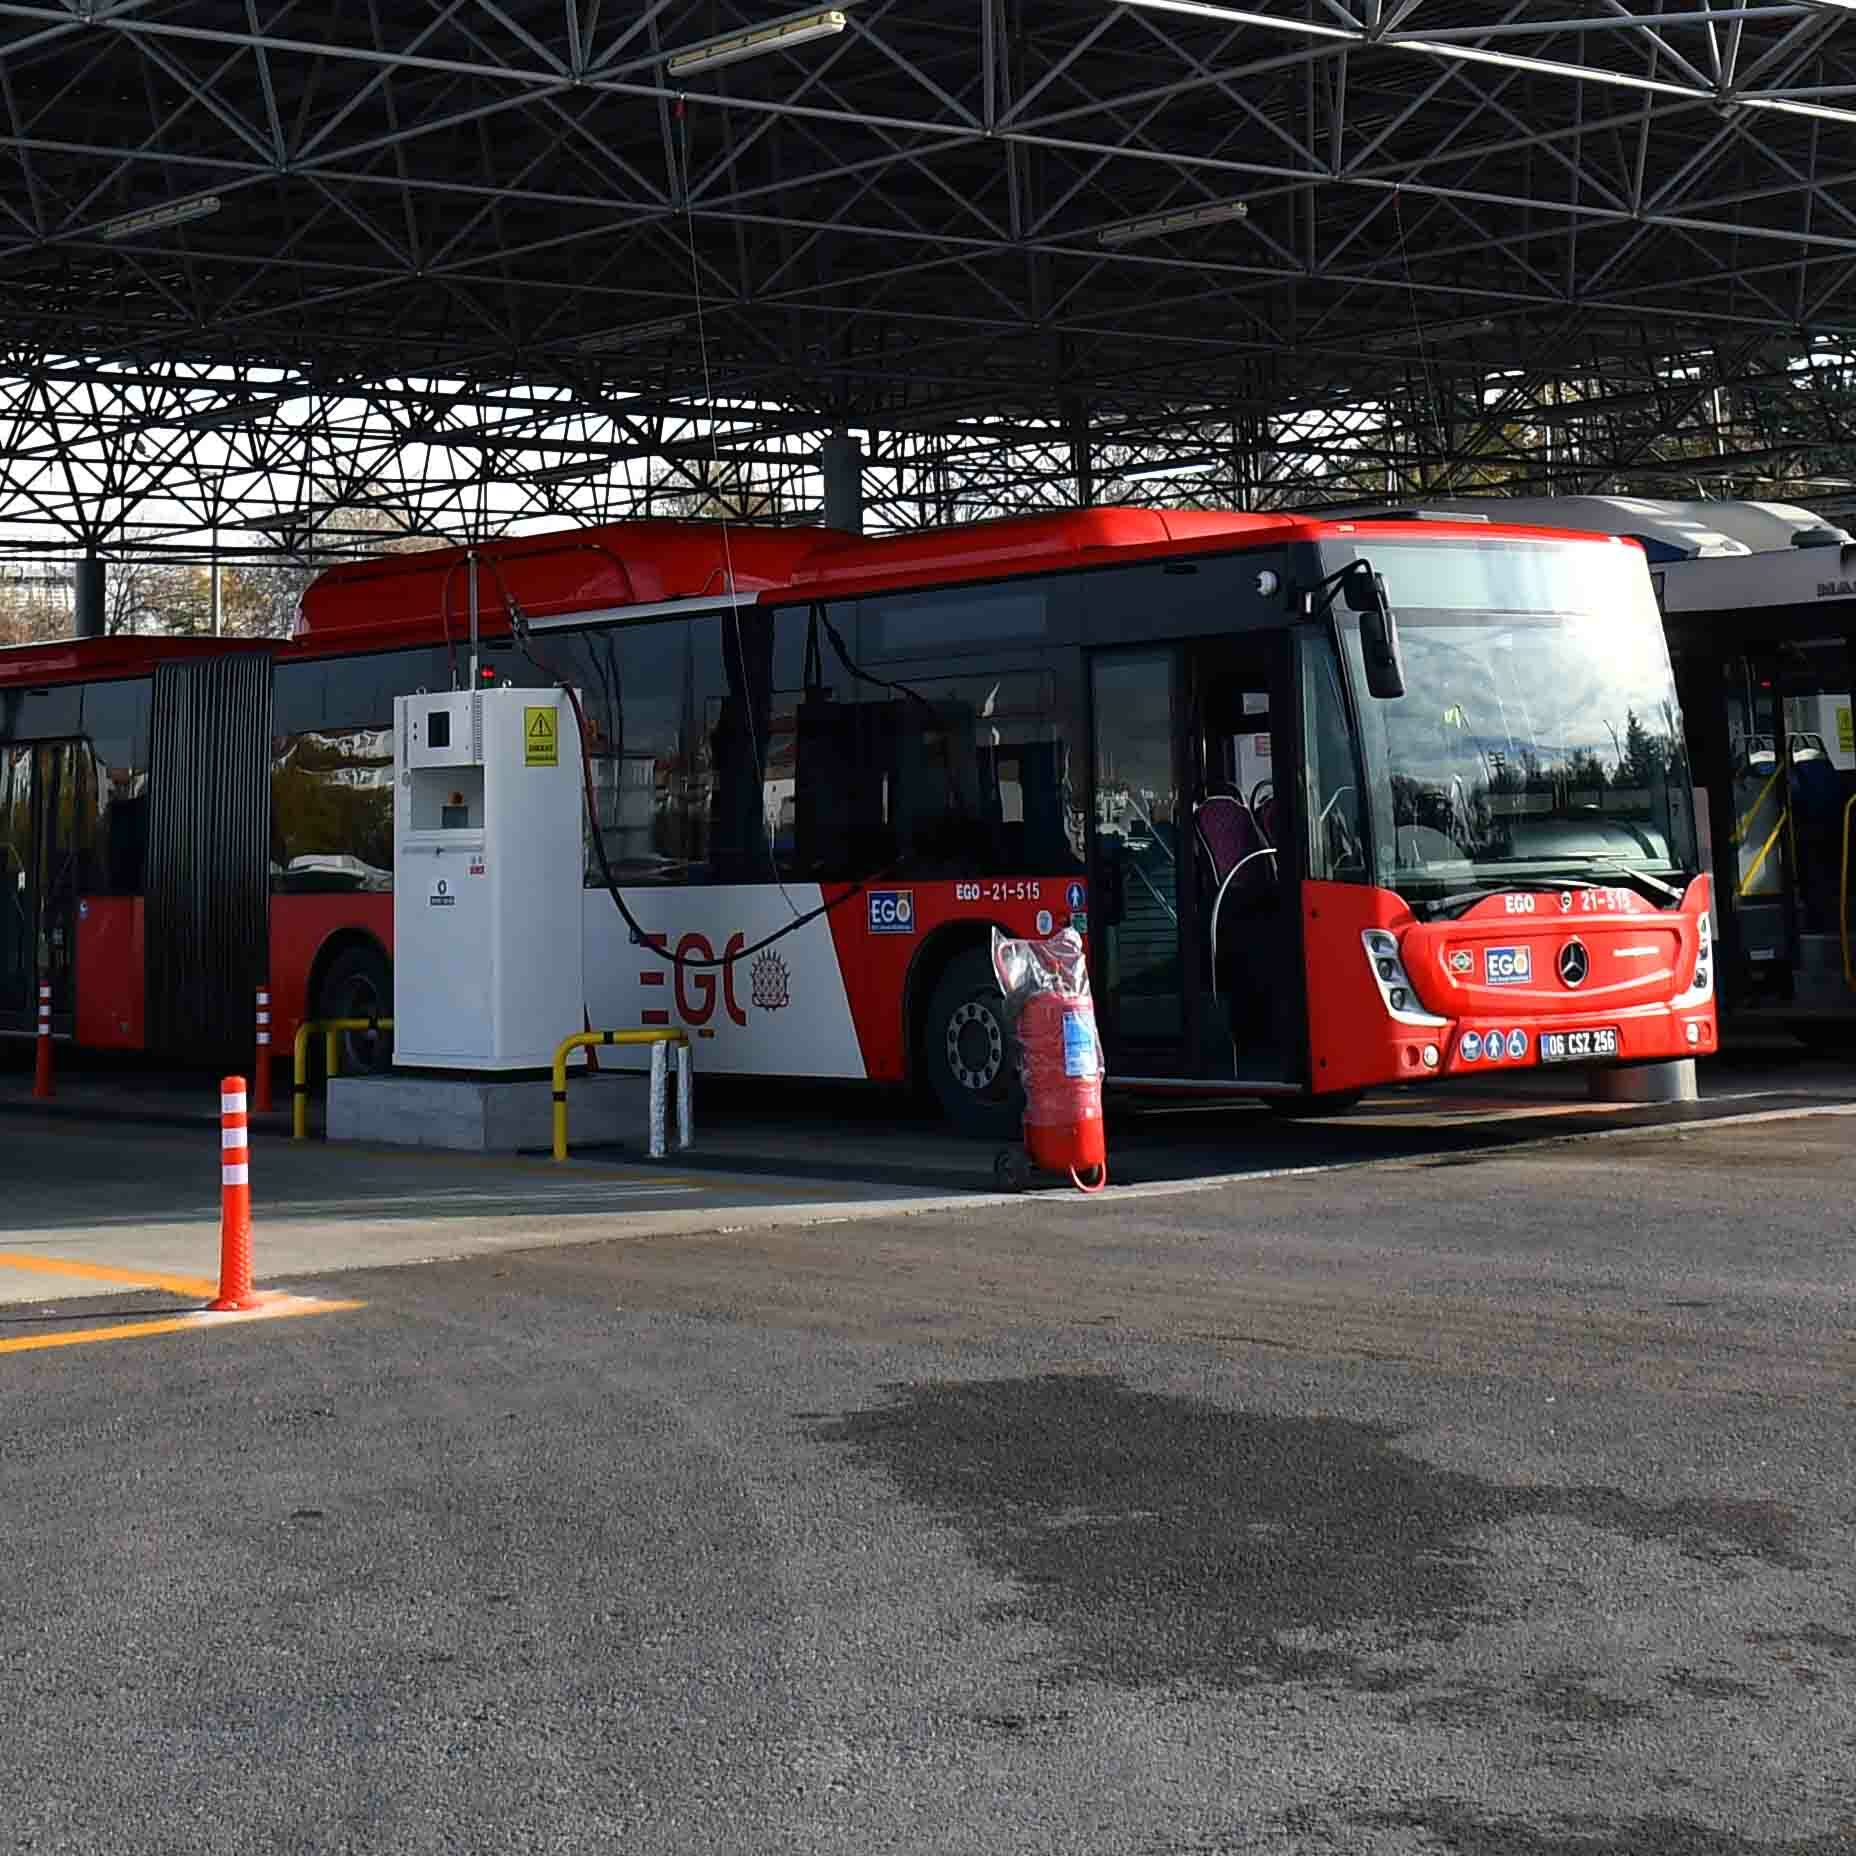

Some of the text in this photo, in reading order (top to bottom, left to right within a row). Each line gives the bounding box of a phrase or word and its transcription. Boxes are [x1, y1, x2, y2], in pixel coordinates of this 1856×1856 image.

[871, 899, 911, 923] EGO
[1505, 893, 1536, 912] EGO
[1488, 950, 1528, 976] EGO
[1549, 1030, 1615, 1055] 06 CSZ 256
